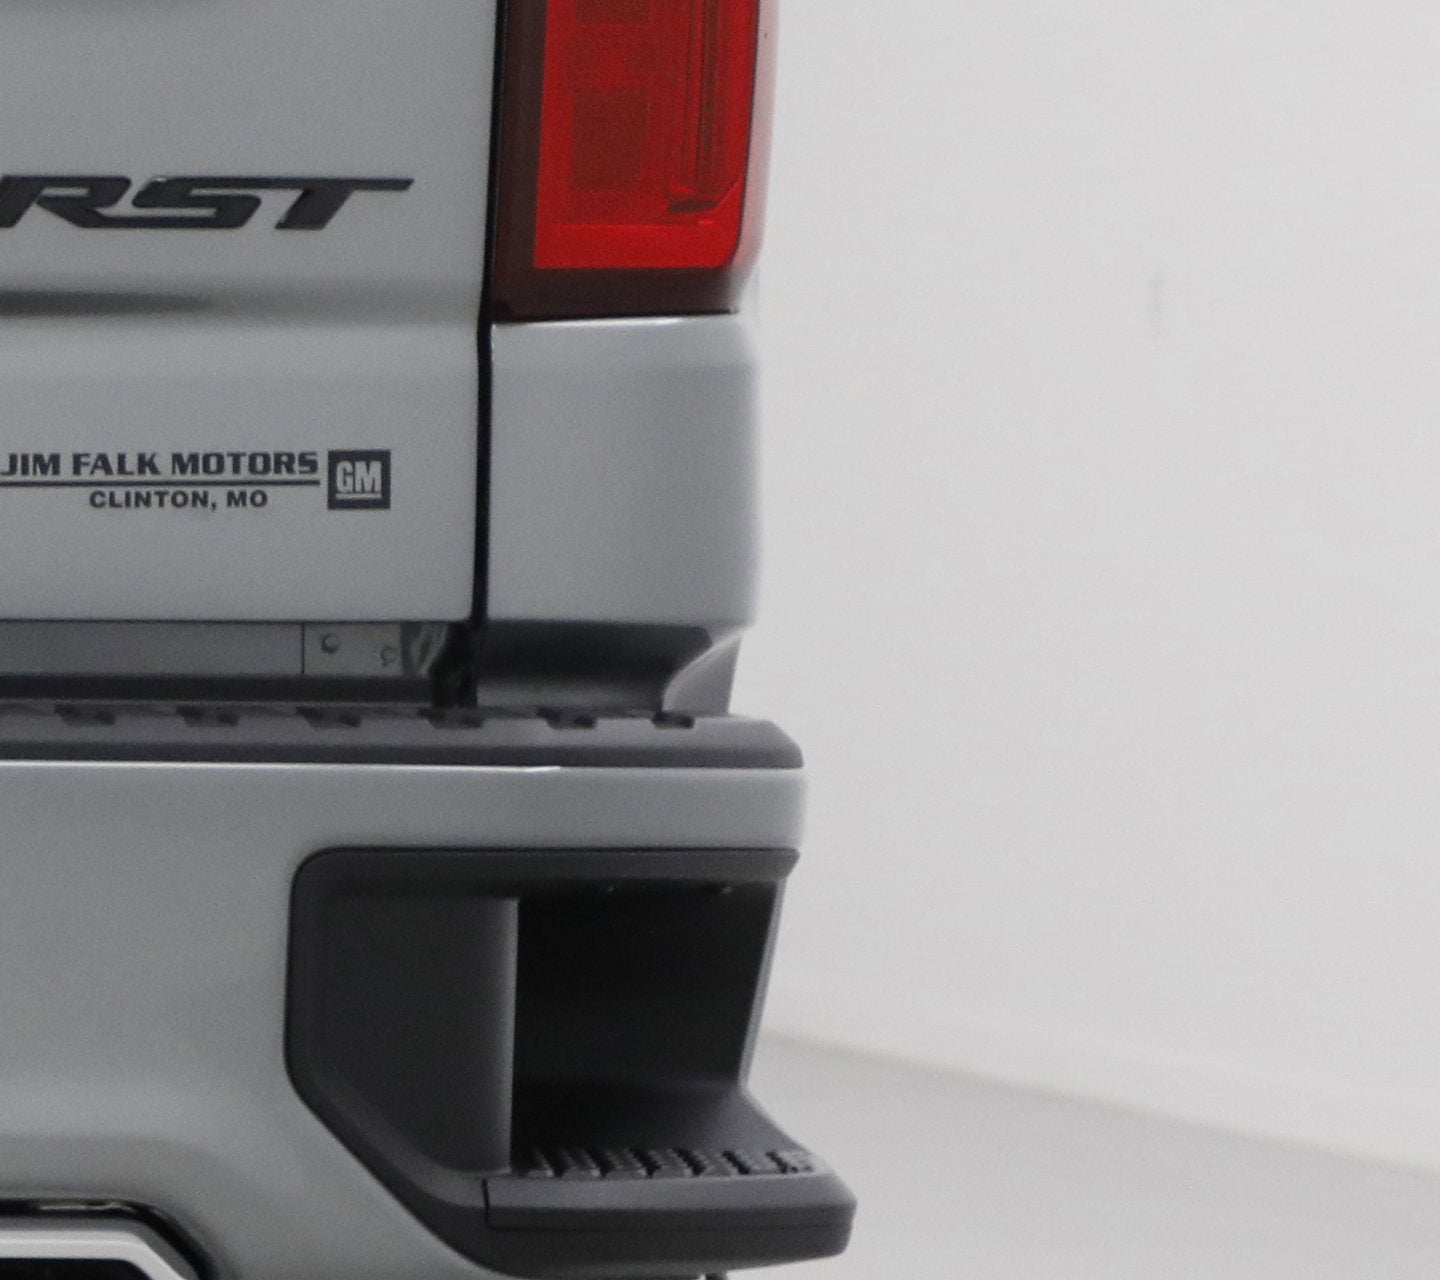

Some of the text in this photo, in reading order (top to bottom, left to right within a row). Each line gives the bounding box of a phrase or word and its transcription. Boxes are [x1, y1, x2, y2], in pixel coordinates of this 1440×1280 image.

[0, 451, 319, 477] JIM FALK MOTORS
[336, 460, 383, 496] GM
[89, 489, 269, 511] CLINTON, MO
